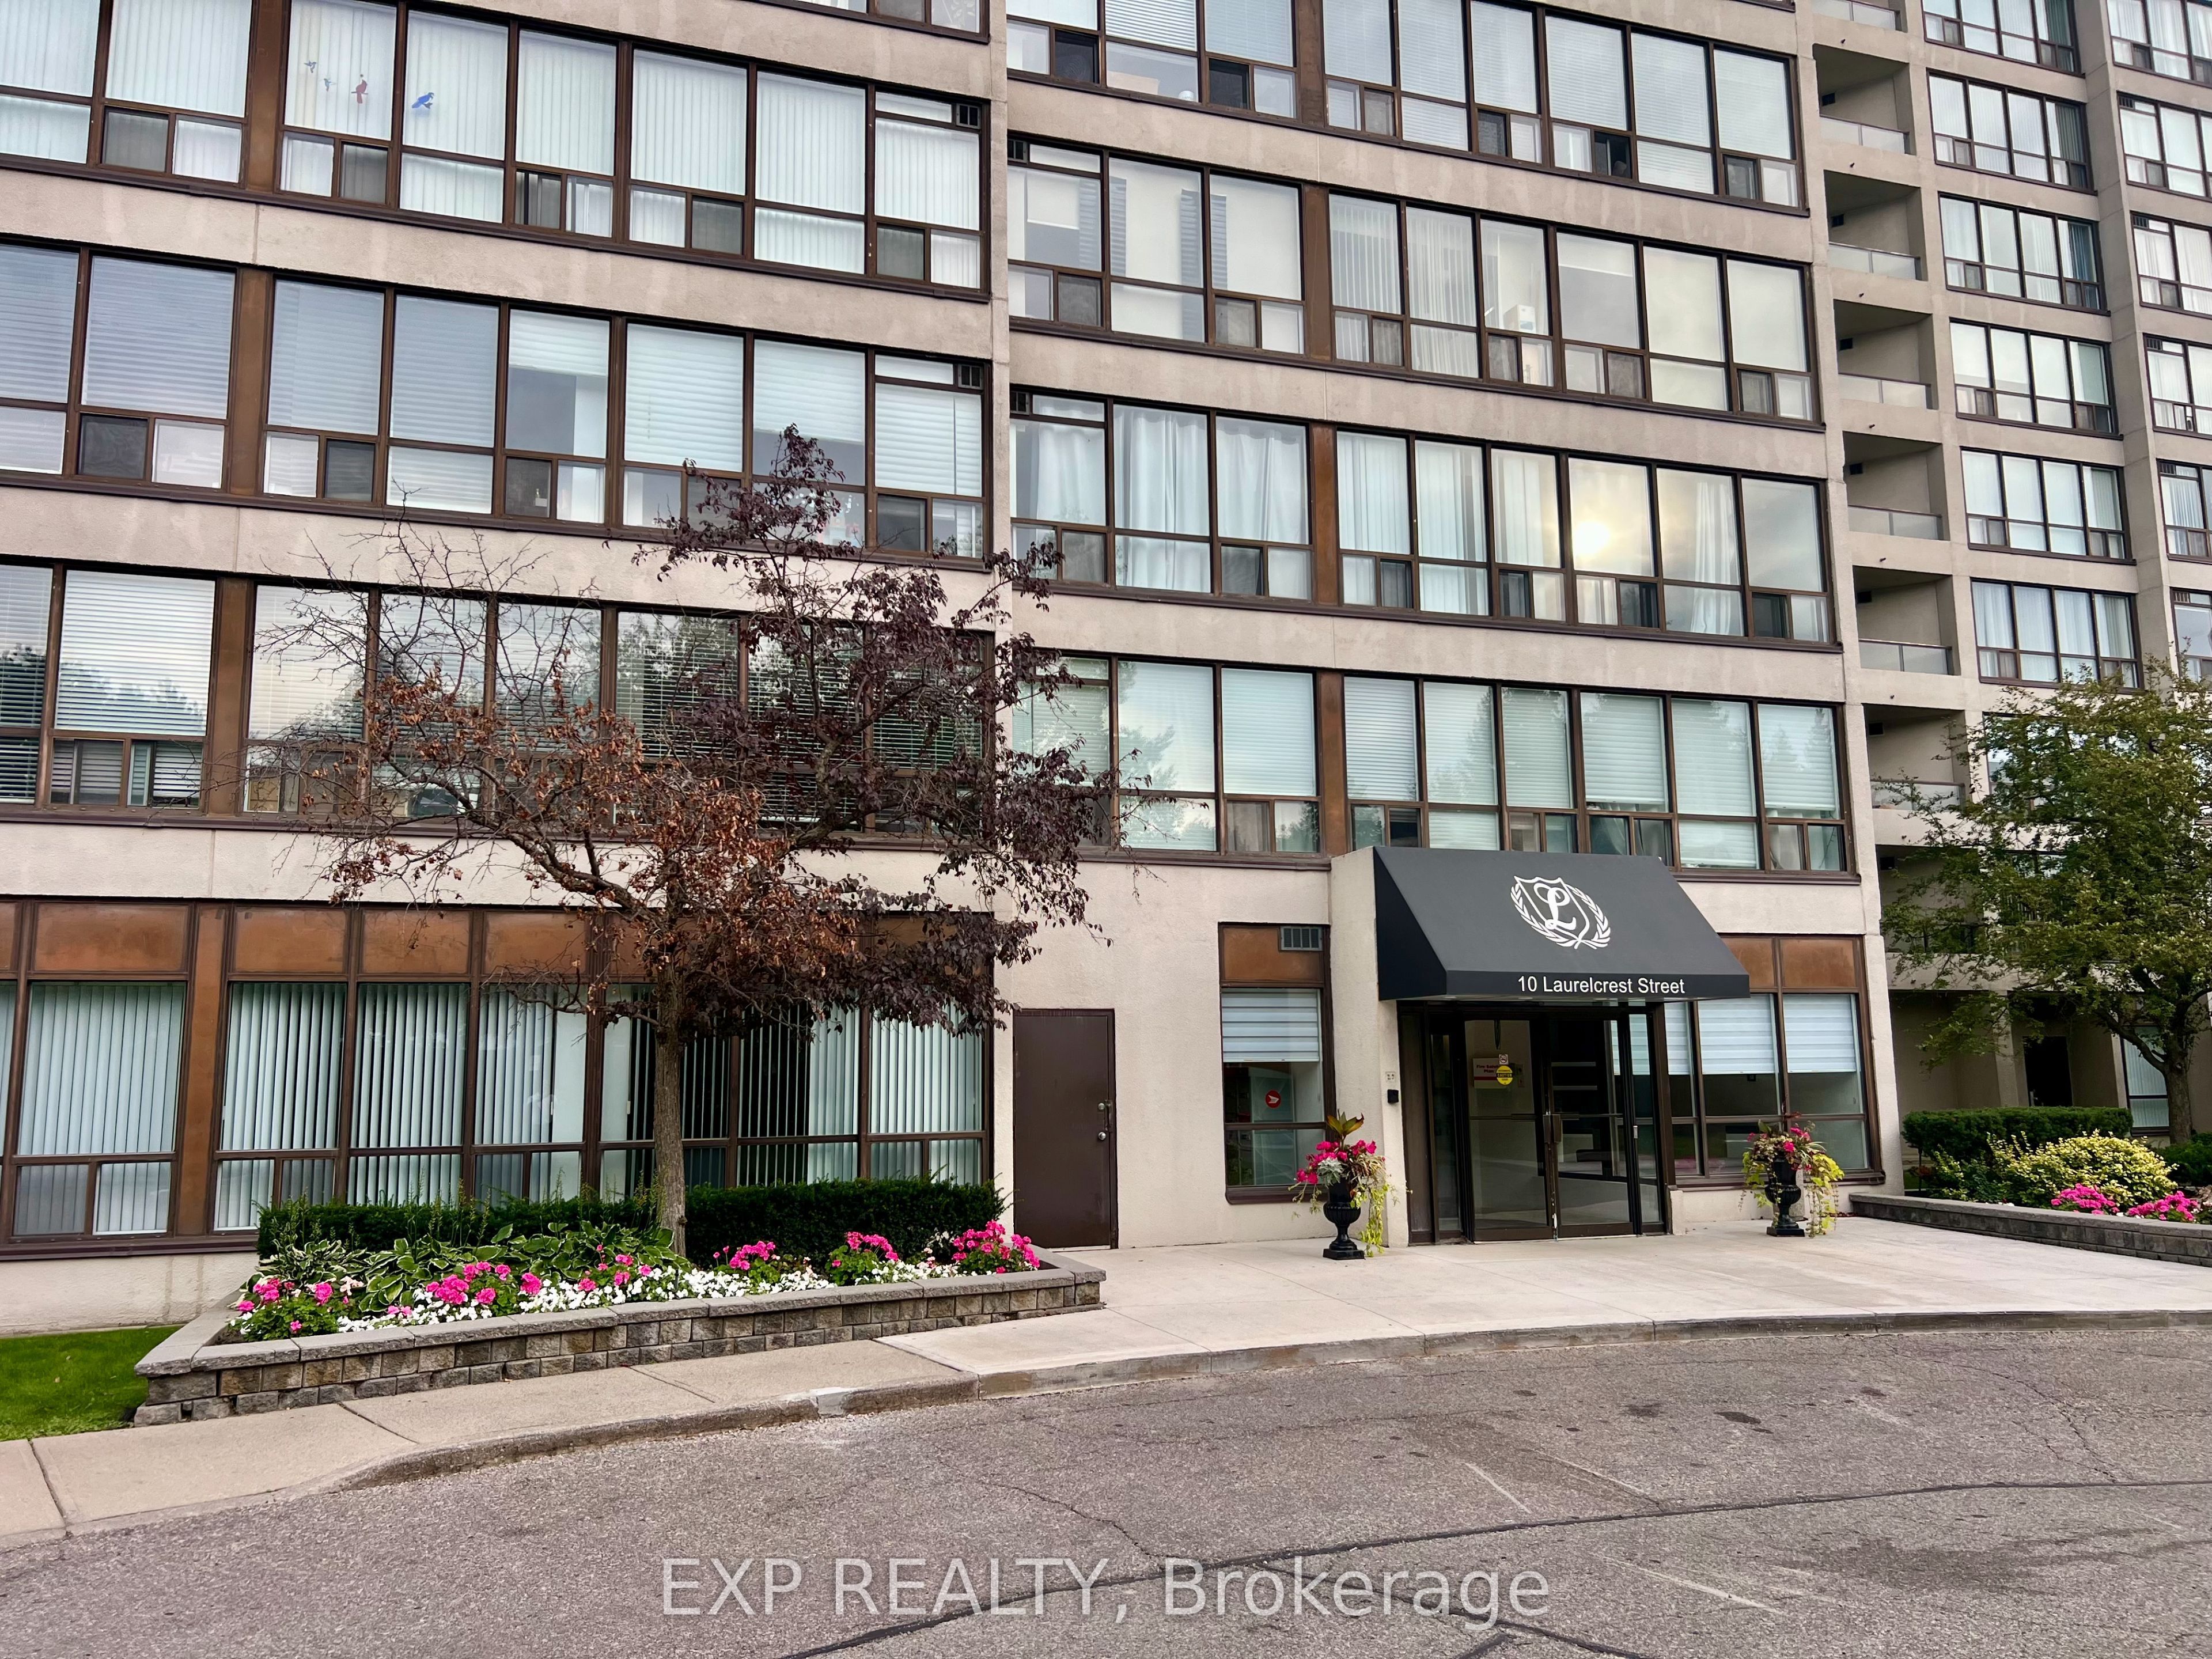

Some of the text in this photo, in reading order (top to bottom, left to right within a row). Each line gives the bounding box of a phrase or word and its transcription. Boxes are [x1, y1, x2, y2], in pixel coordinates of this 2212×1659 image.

[1518, 976, 1685, 994] 10 Laurelcrest Street
